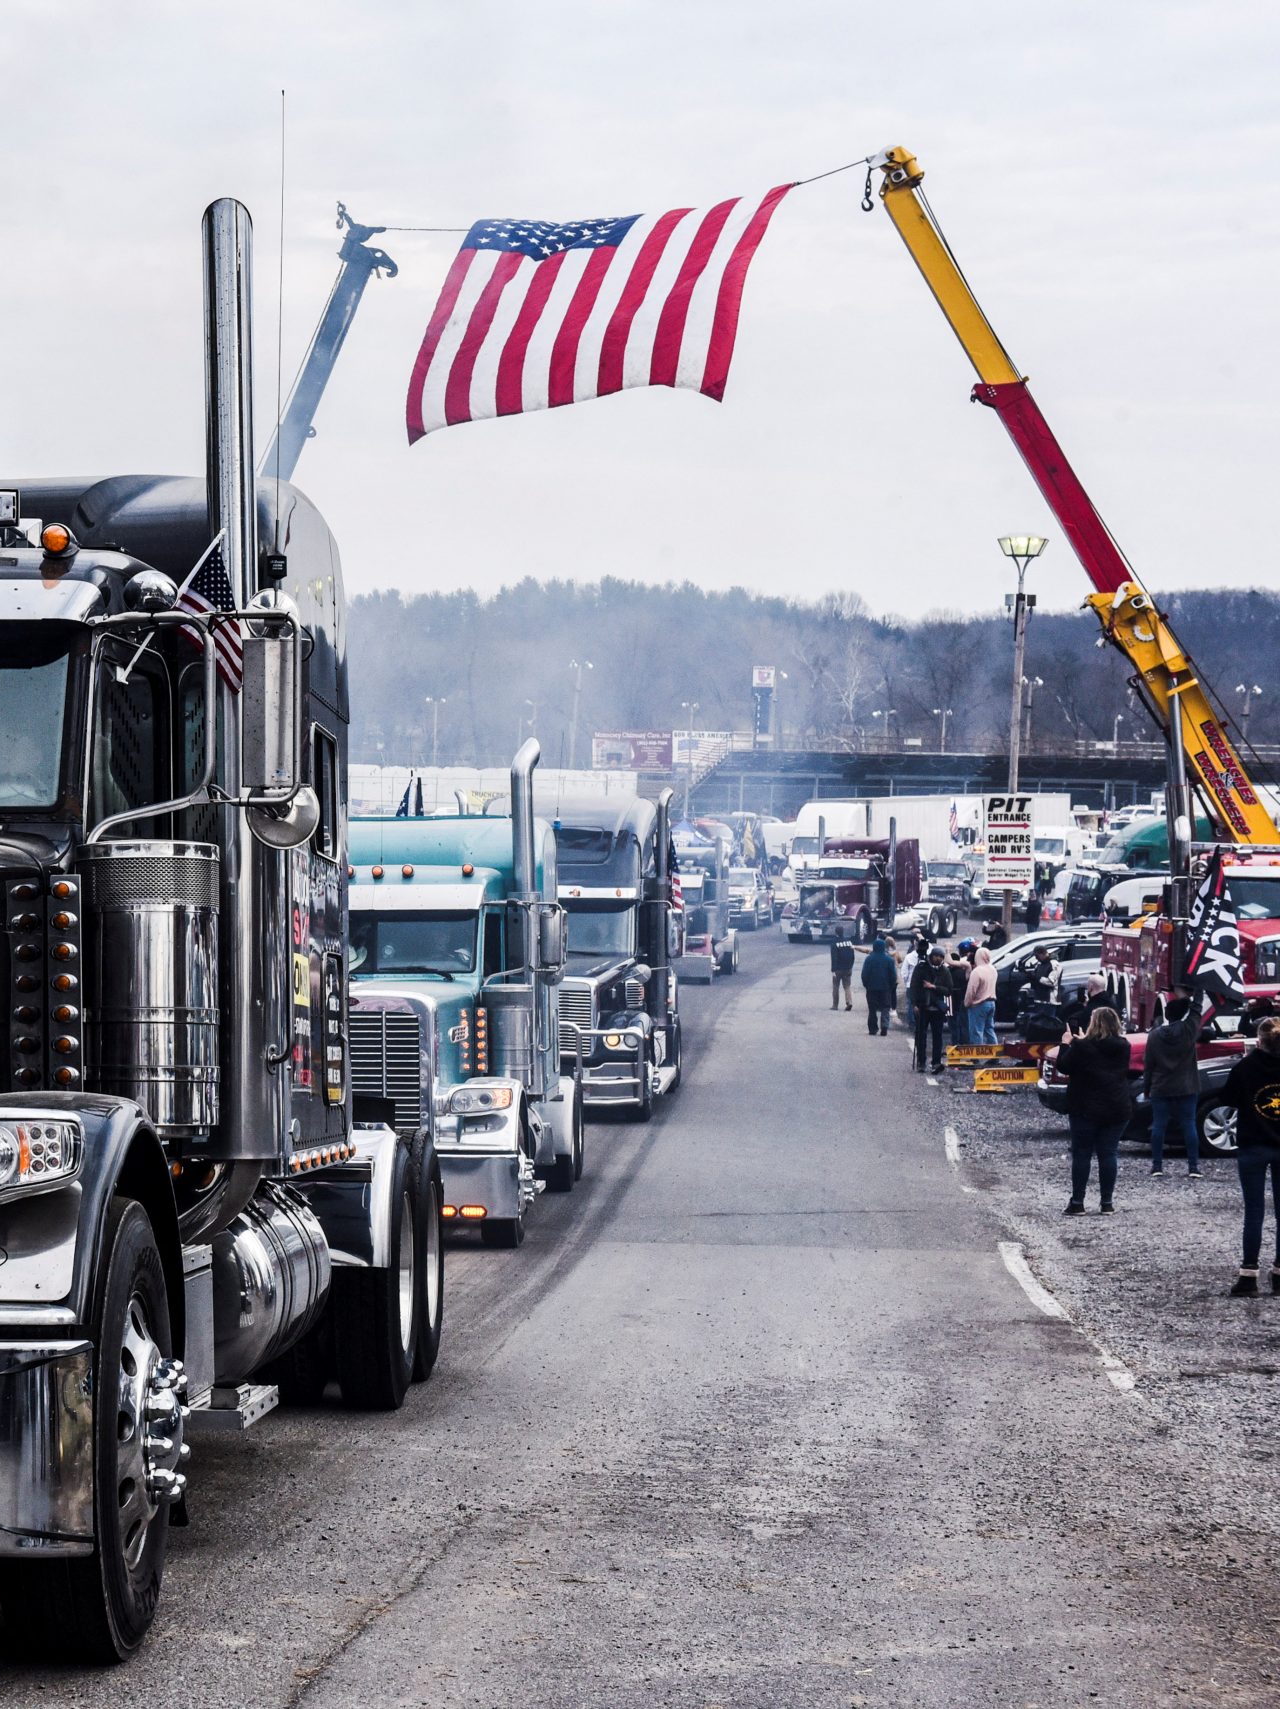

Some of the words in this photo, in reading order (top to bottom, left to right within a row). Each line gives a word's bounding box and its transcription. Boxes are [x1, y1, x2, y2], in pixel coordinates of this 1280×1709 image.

[1200, 720, 1258, 806] WRENCHES
[1194, 750, 1252, 836] WRECKERS
[987, 797, 1032, 812] PIT
[987, 813, 1032, 822] ENTRANCE
[988, 834, 1031, 844] CAMPERS
[988, 845, 1007, 854] AND
[1011, 845, 1031, 854] RV'S
[958, 1047, 974, 1056] STAY
[976, 1047, 994, 1056] BACK
[991, 1071, 1024, 1081] CAUTION
